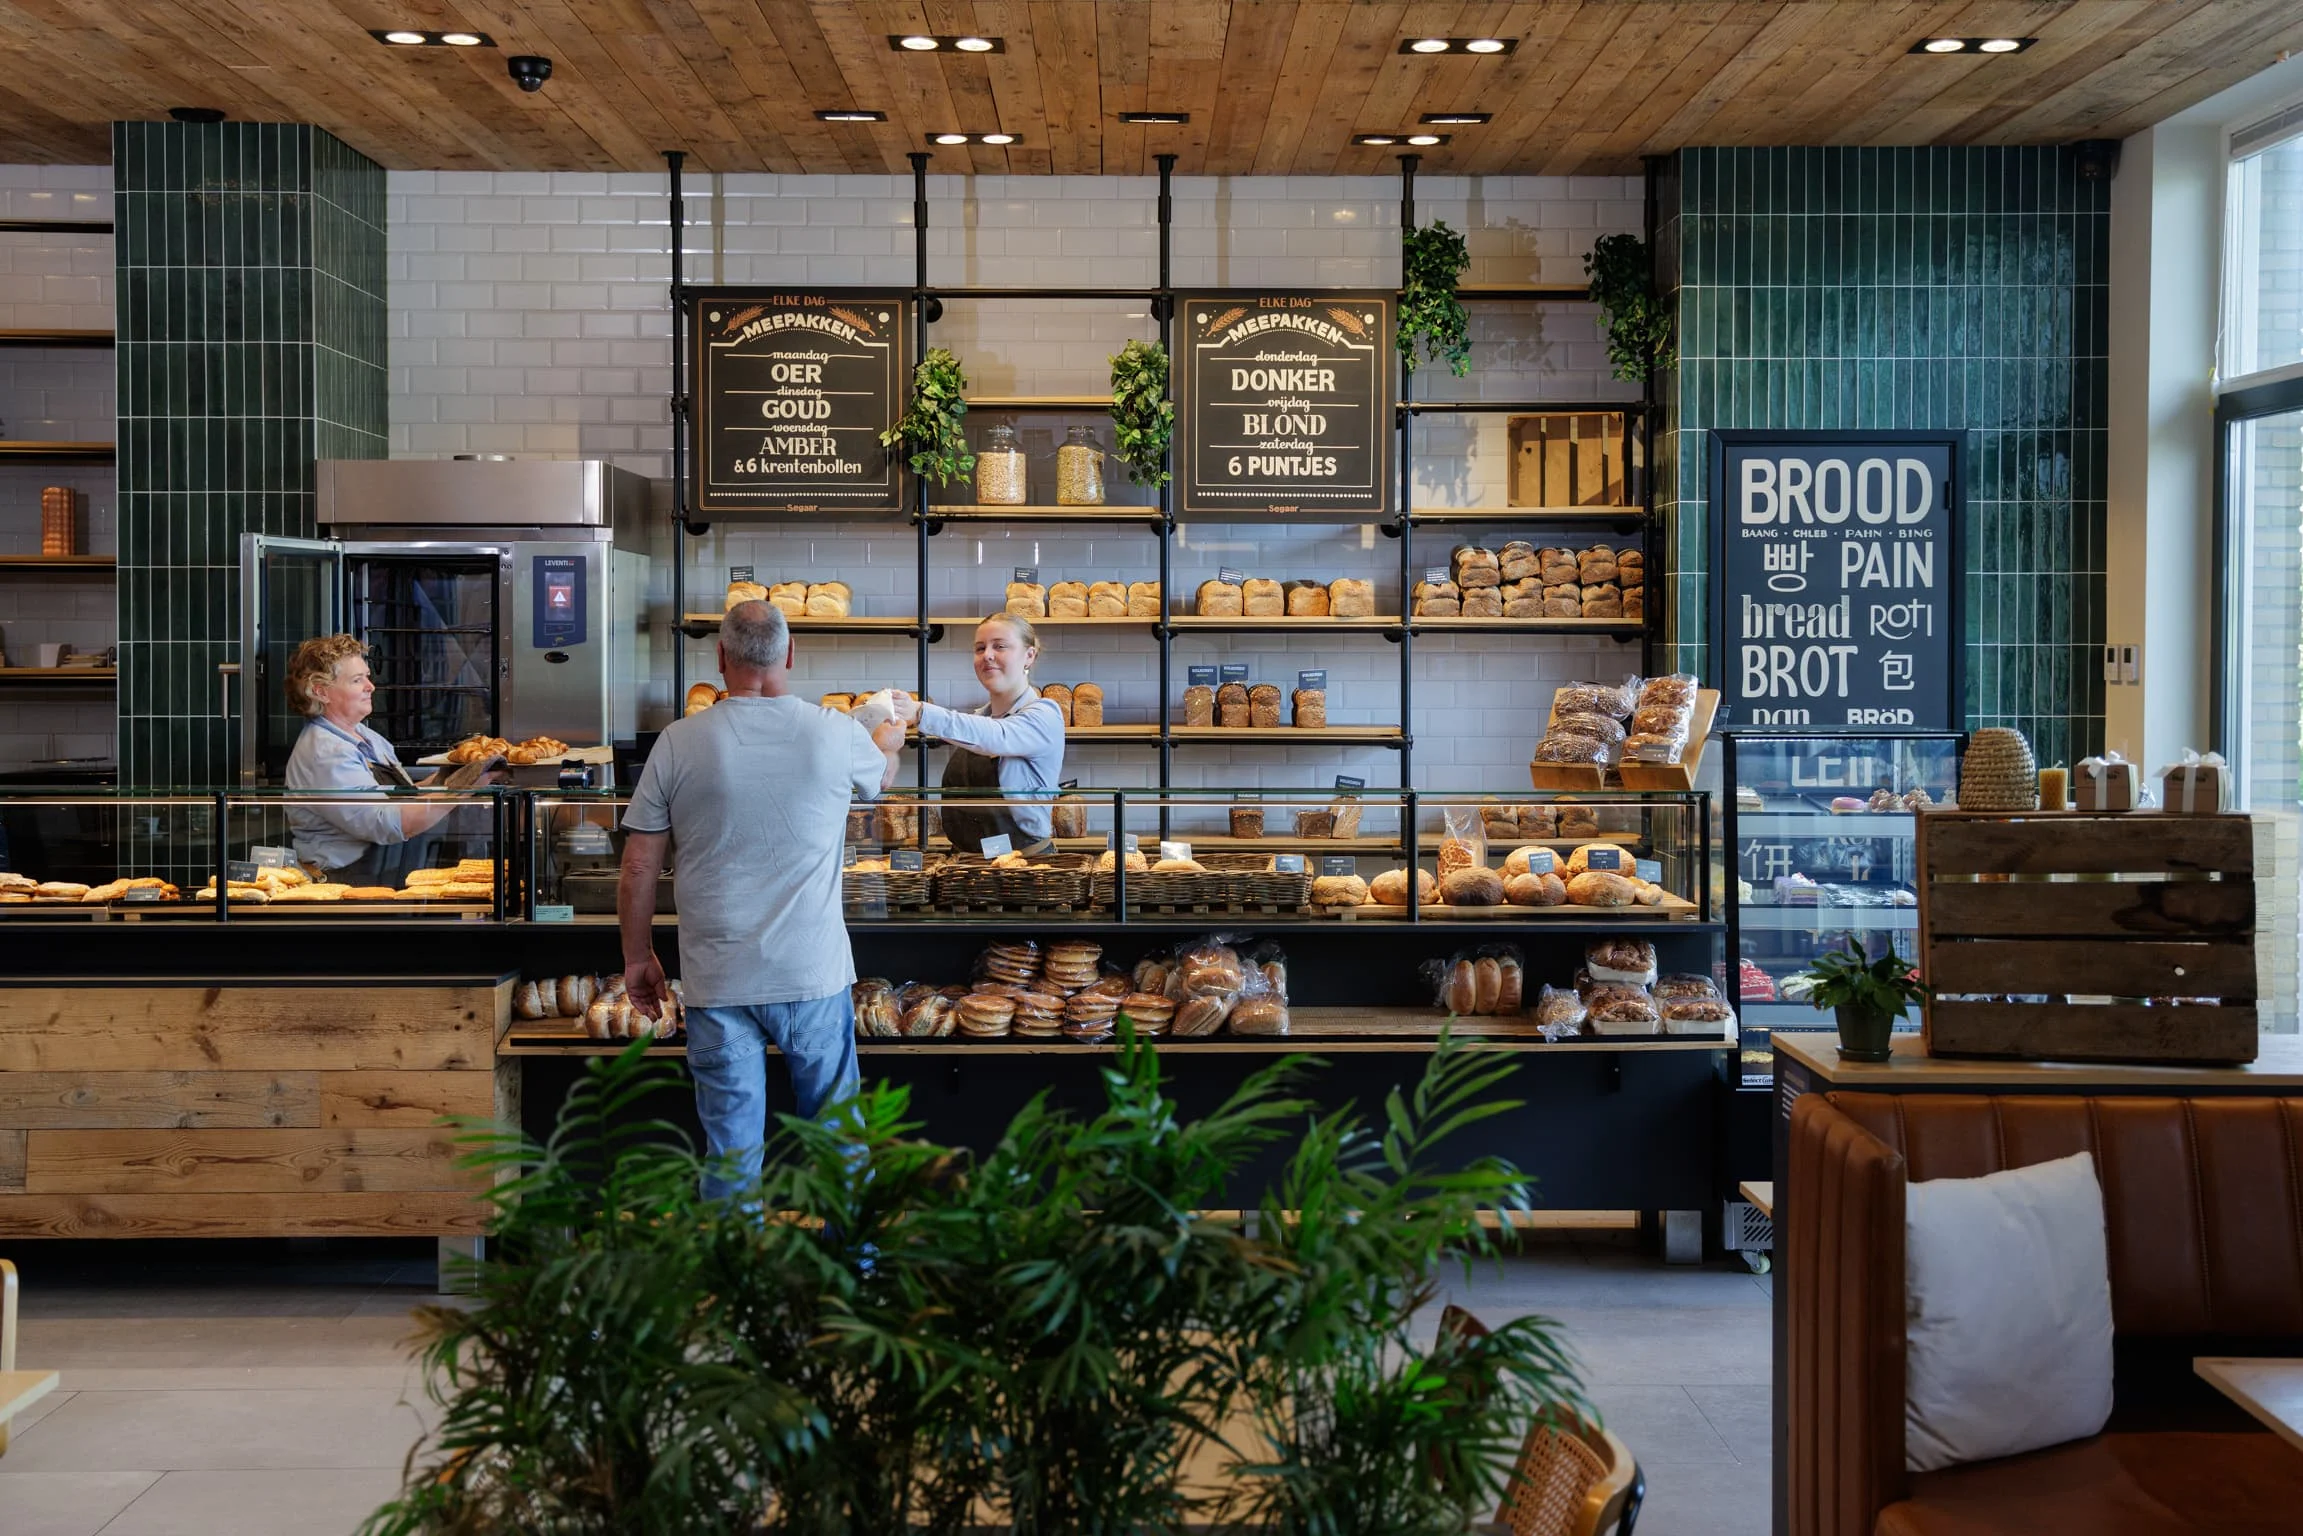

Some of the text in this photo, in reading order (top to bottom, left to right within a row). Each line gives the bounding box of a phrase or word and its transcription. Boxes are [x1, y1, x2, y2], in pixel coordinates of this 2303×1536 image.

[773, 295, 825, 306] ELKE DAG
[1260, 299, 1311, 308] ELKE DAG
[743, 312, 856, 341] MEEPAKKEN
[1228, 313, 1342, 344] MEEPAKKEN
[773, 350, 829, 364] maandag
[1255, 351, 1318, 366] donderdag
[771, 363, 822, 383] OER
[1232, 368, 1335, 392] DONKER
[777, 385, 822, 399] dinsdag
[762, 400, 831, 419] GOUD
[1267, 396, 1310, 413] vrijdag
[773, 421, 828, 436] woensdag
[1243, 414, 1327, 435] BLOND
[760, 437, 837, 456] AMBER
[1260, 437, 1314, 455] zaterdag
[734, 458, 862, 475] & 6 krentenbollen
[1228, 455, 1337, 476] 6 PUNTJES
[1741, 458, 1933, 524] BROOD
[1742, 529, 1933, 538] BAANG CHLEB PAHN BING
[1764, 540, 1814, 593] 빵
[1841, 541, 1933, 589] PAIN
[1741, 594, 1852, 639] bread
[1742, 645, 1858, 698] BROT
[1879, 650, 1915, 691] 包
